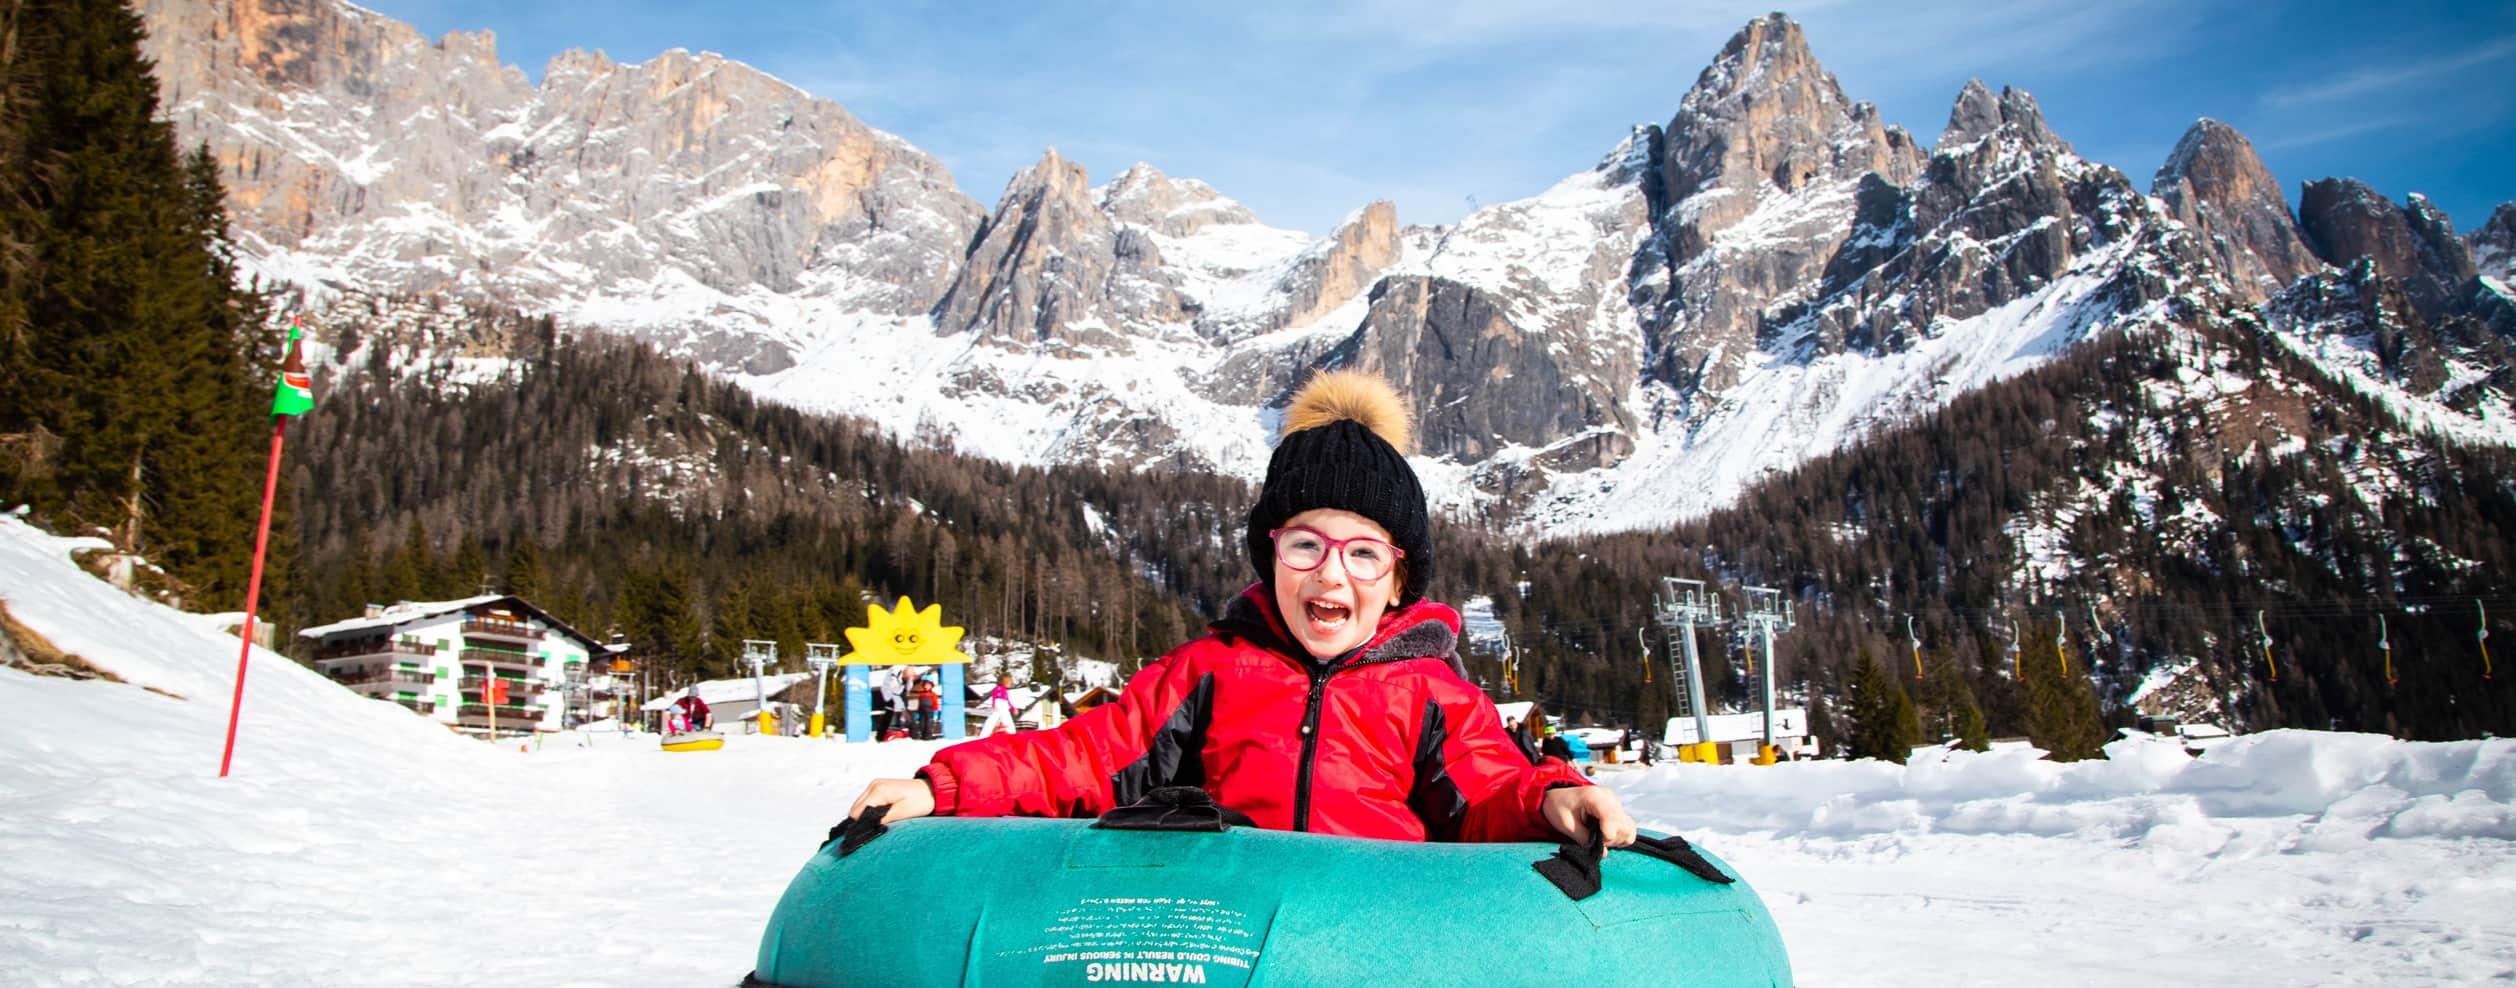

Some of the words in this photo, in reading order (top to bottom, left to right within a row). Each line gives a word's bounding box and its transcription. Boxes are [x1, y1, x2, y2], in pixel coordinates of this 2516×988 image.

[1043, 952, 1078, 963] INJURY
[1080, 950, 1121, 960] SERIOUS
[1123, 951, 1135, 960] IN
[1136, 950, 1175, 960] RESULT
[1177, 951, 1211, 962] COULD
[1213, 954, 1250, 969] TUBING
[1086, 962, 1206, 984] WARNING
